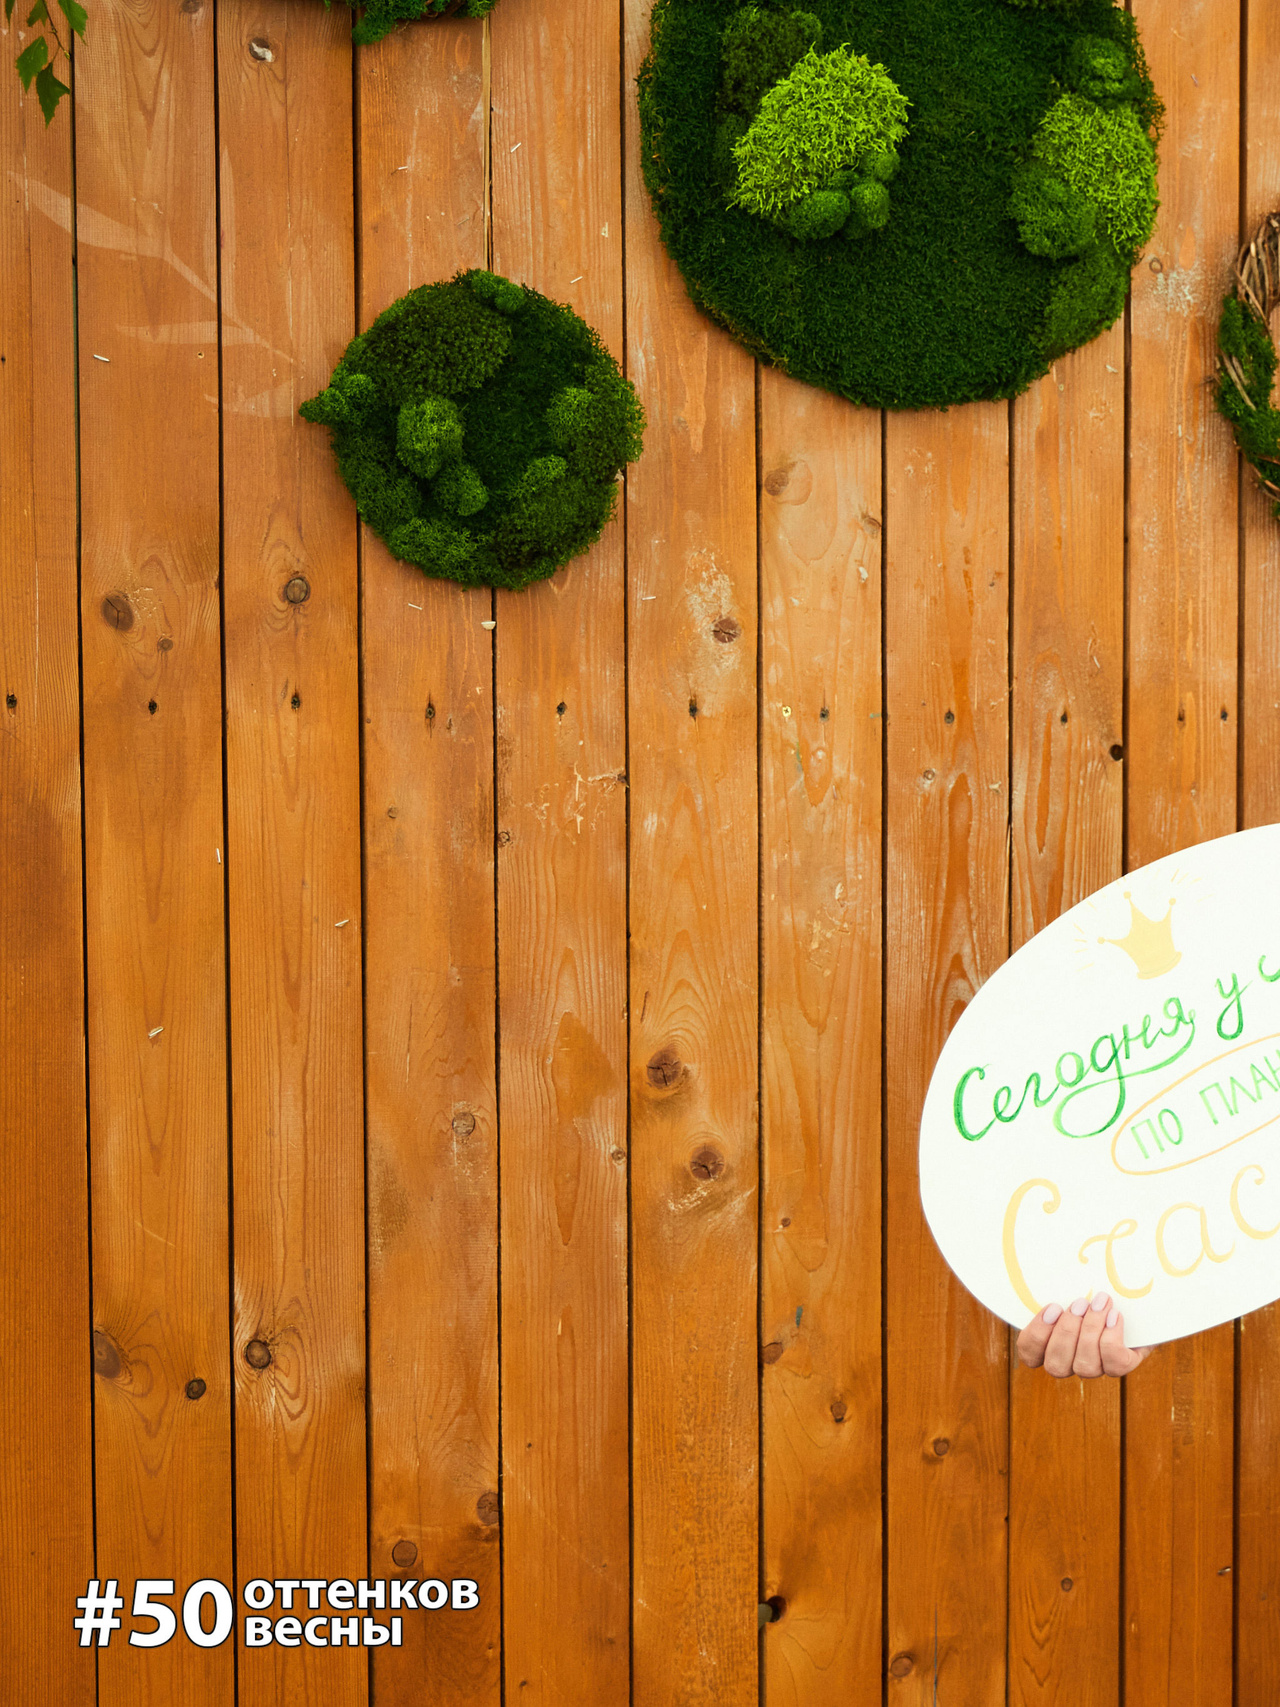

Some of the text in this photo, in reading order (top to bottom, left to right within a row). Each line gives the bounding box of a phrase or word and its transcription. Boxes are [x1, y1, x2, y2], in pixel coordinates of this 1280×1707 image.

[952, 996, 1198, 1139] Сегодня
[1214, 972, 1254, 1041] у
[1130, 1107, 1185, 1160] ПО
